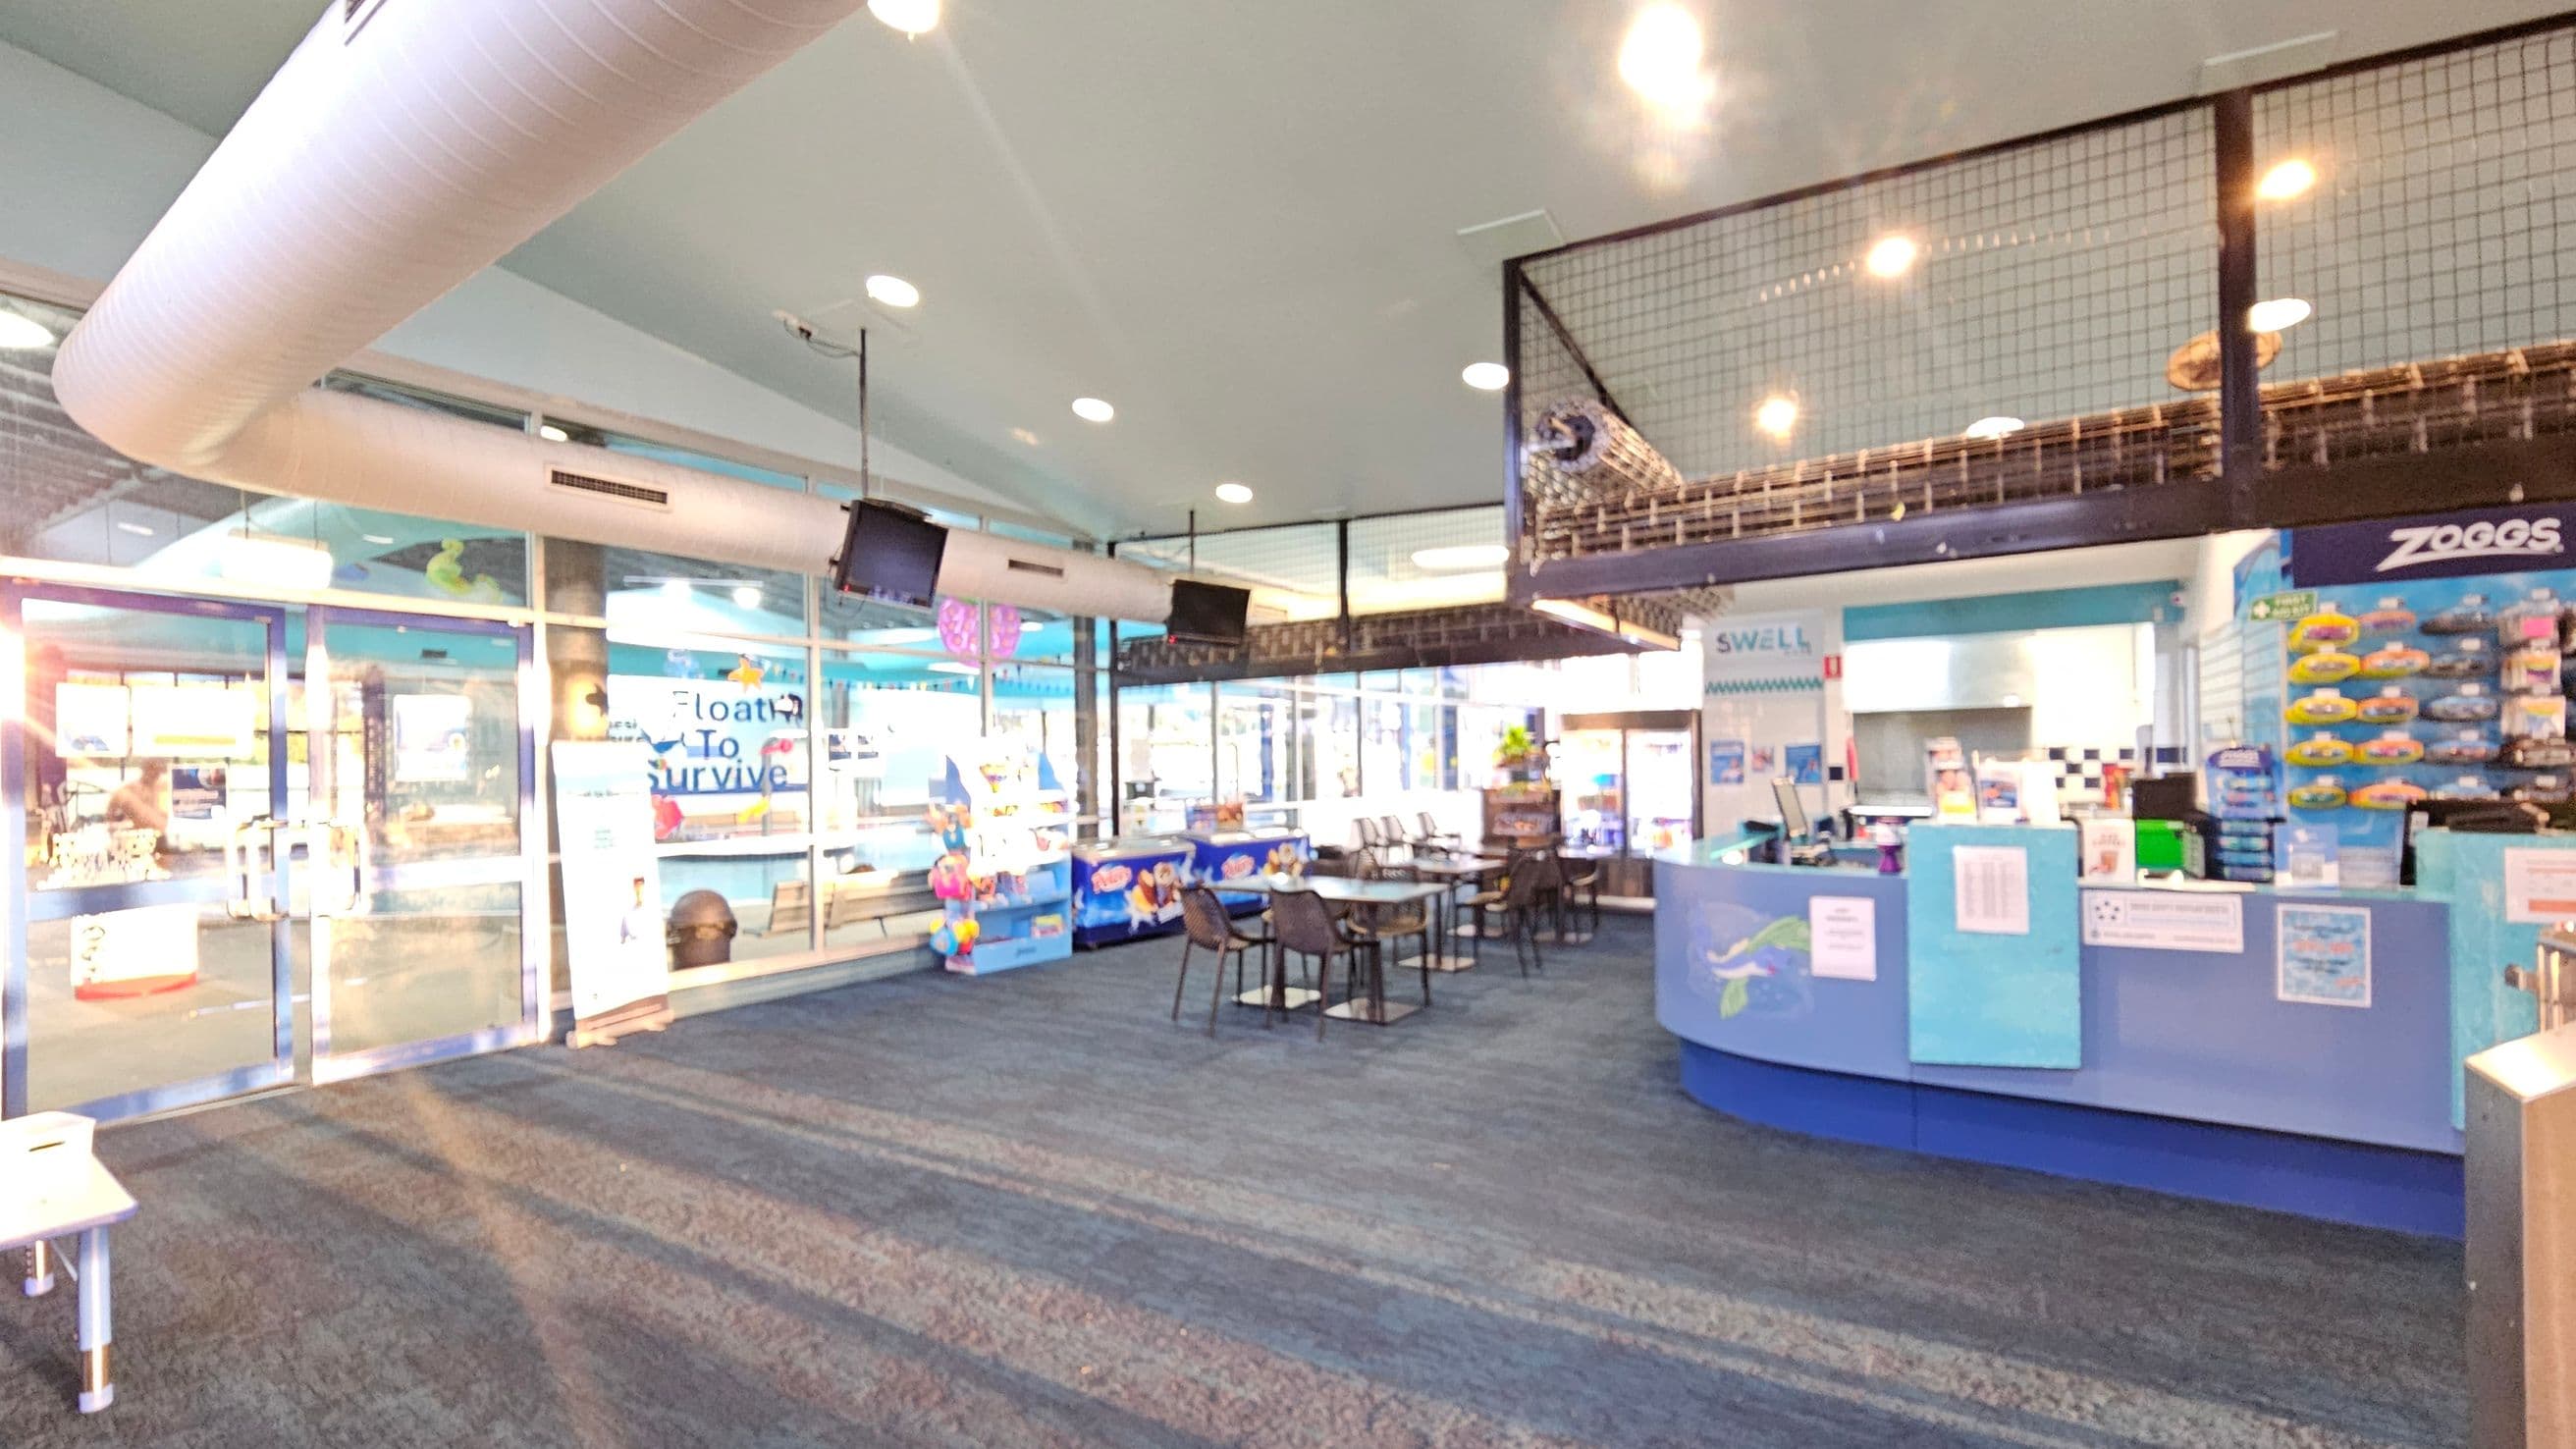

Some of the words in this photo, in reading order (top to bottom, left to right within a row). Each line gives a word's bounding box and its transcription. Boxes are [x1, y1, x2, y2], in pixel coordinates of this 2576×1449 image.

[2375, 517, 2564, 571] ZOGGS
[1716, 627, 1812, 654] SWELL
[696, 728, 740, 760] To
